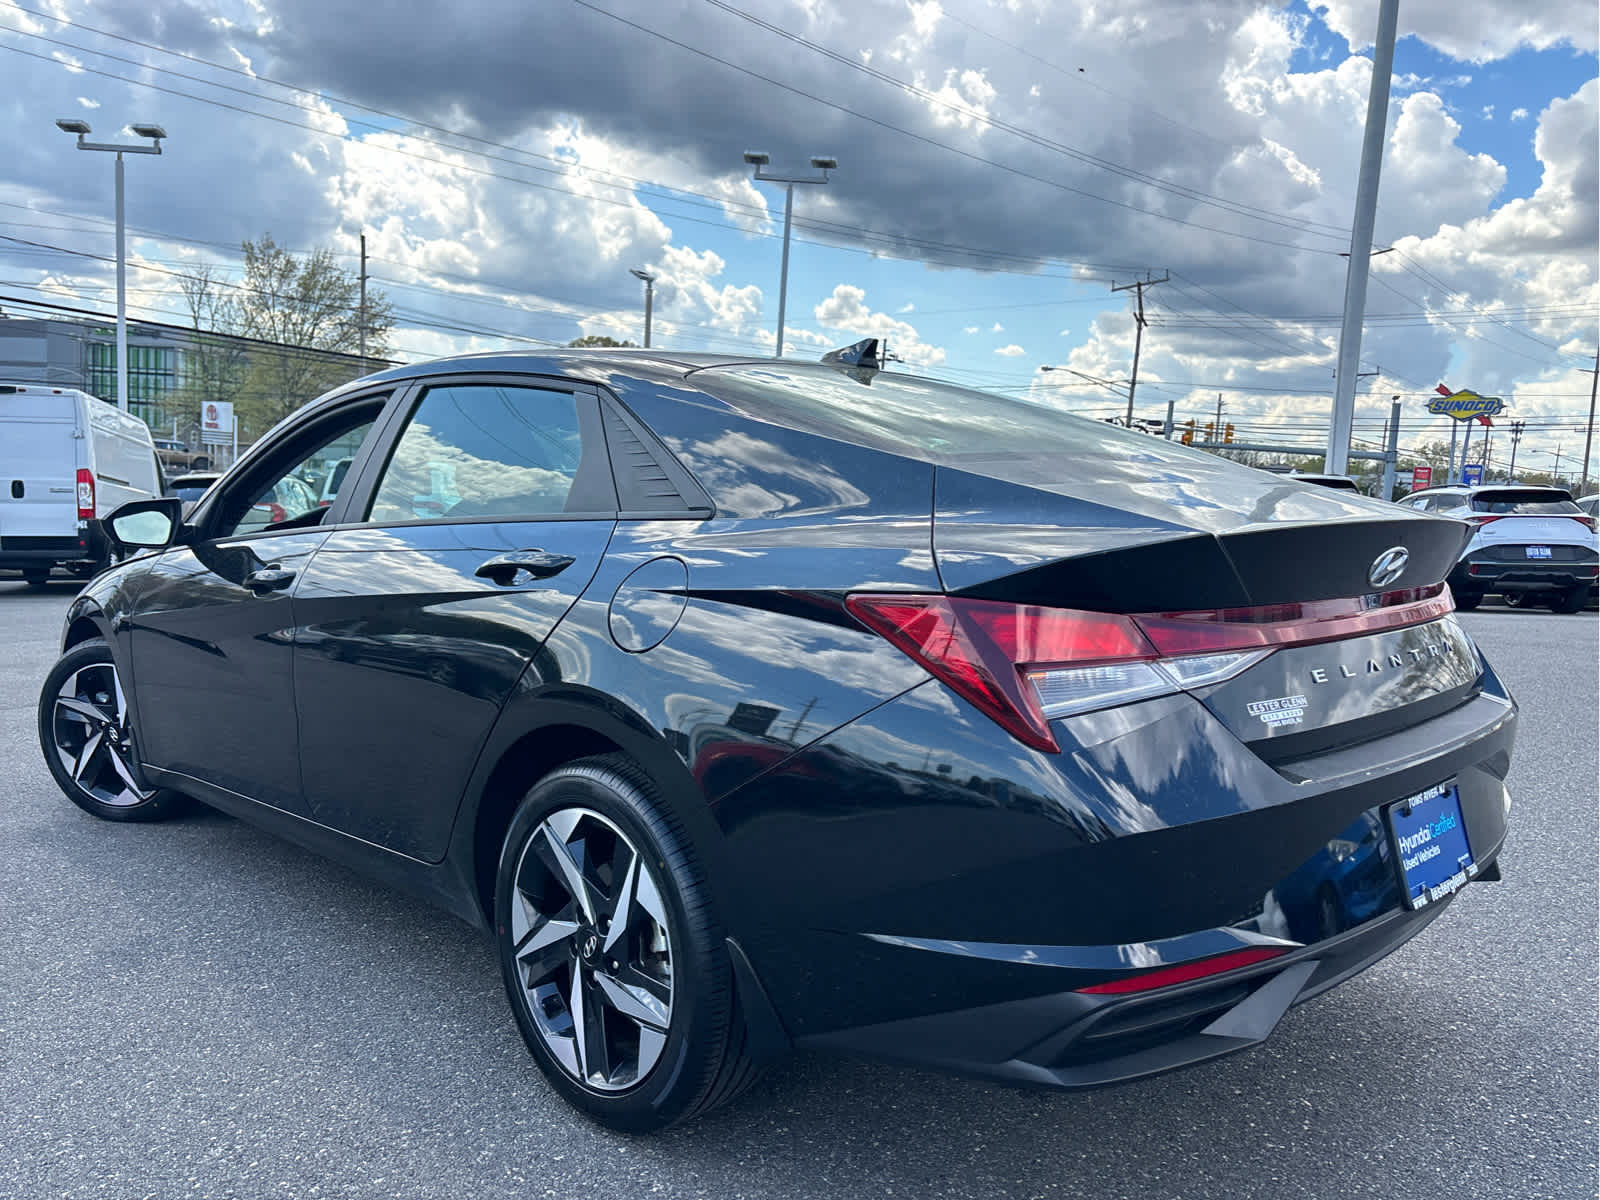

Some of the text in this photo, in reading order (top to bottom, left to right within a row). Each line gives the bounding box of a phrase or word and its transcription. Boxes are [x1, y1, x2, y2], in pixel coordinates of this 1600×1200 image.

[1433, 400, 1496, 412] SUNOCO
[1310, 641, 1453, 684] ELANTRA
[1247, 697, 1308, 714] LESTER GLENN
[1403, 854, 1420, 871] Used
[1418, 844, 1441, 865] Vehicles
